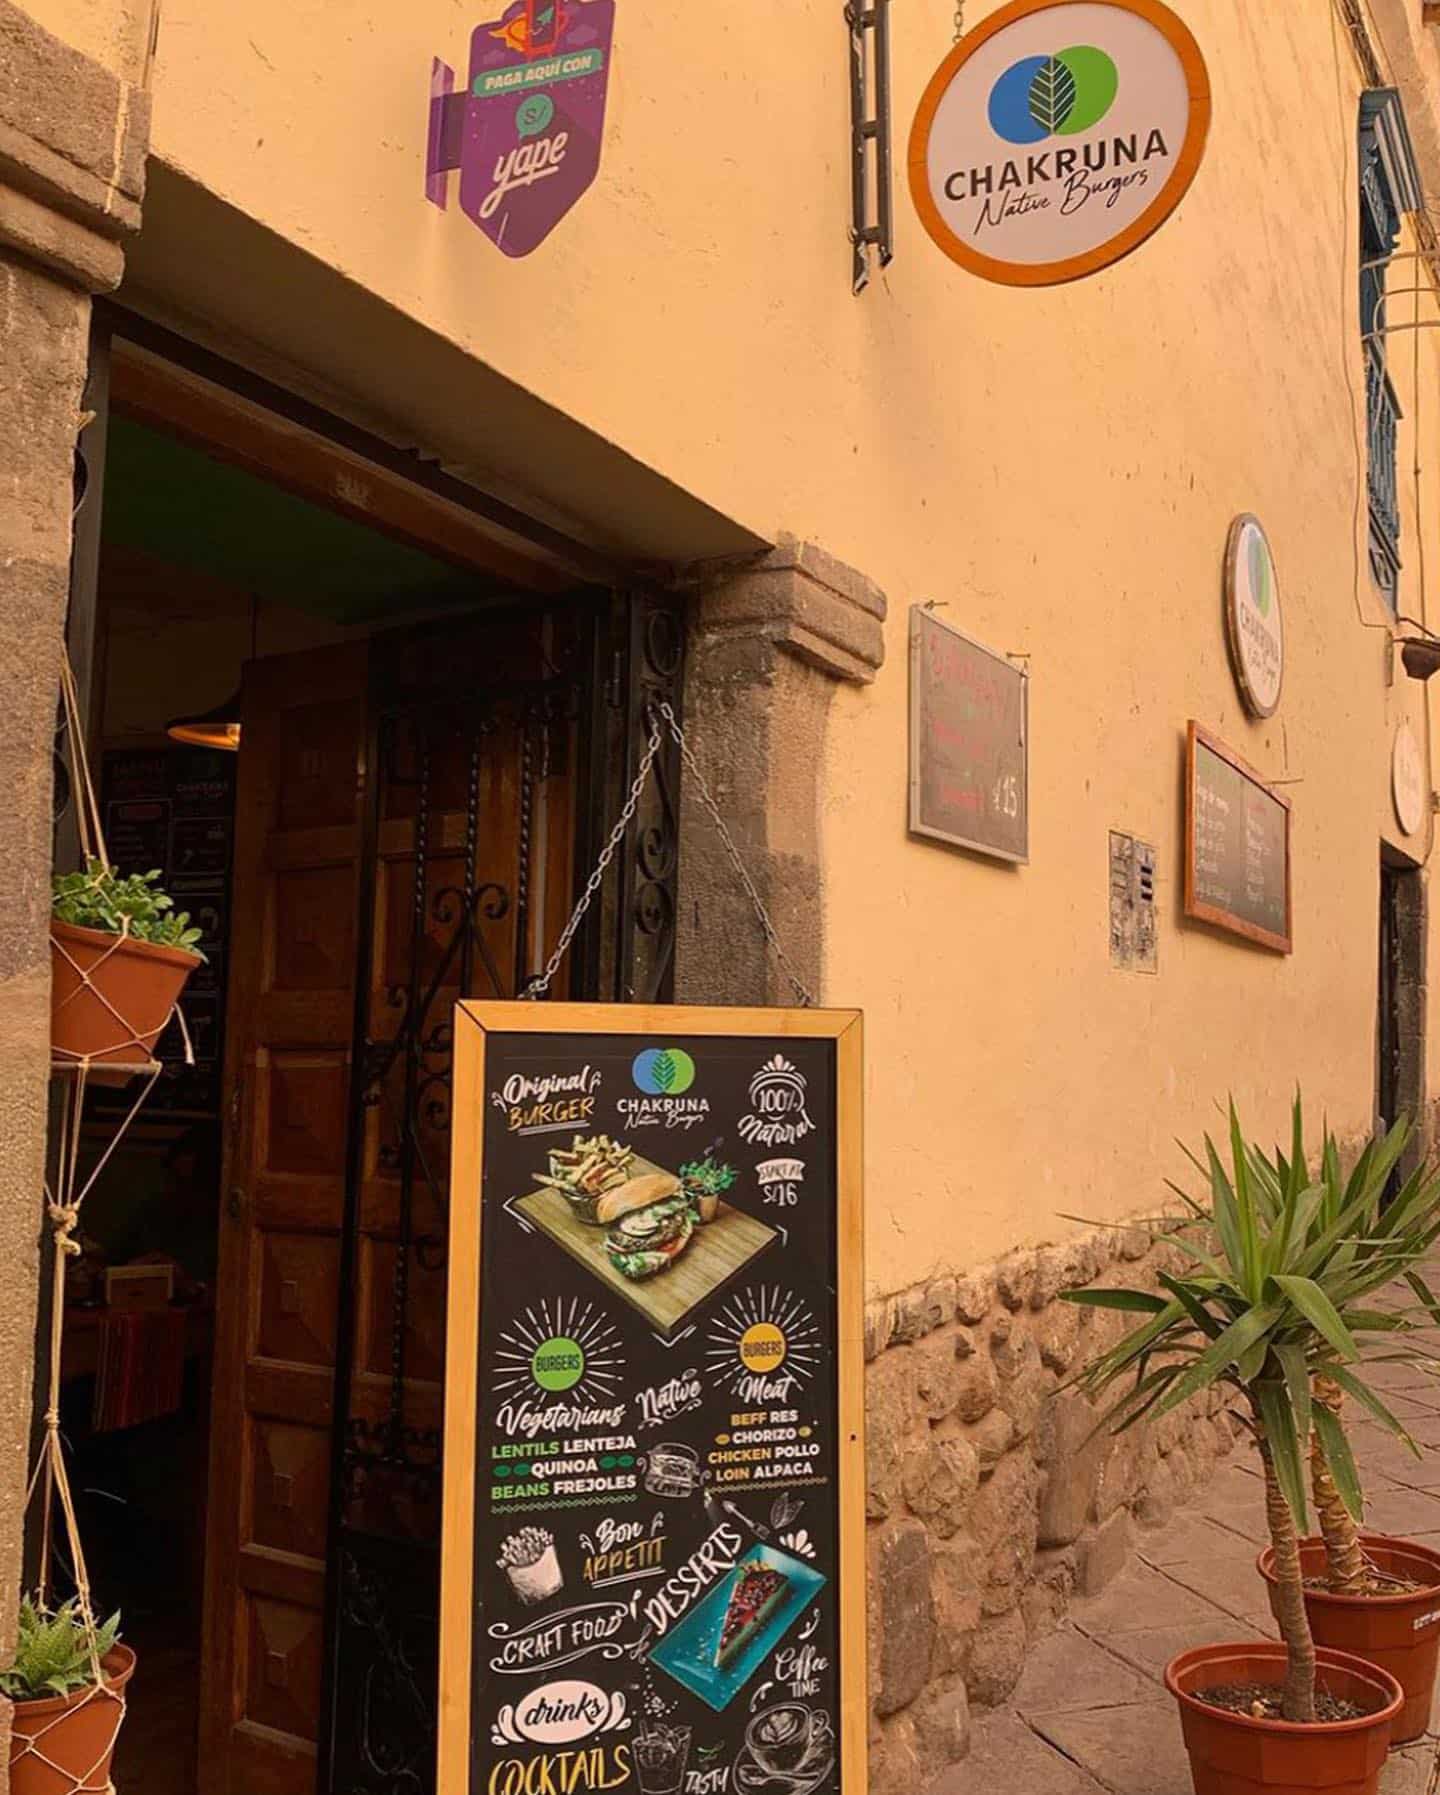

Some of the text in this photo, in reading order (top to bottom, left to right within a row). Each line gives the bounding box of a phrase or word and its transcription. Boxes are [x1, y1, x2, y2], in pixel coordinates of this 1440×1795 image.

[485, 56, 592, 90] PAGA AQUÍ CON
[479, 132, 569, 219] yape
[944, 128, 1169, 201] CHAKRUNA
[974, 168, 1149, 236] Native Burgers
[503, 1065, 590, 1104] Original
[758, 1088, 799, 1113] 100%
[508, 1097, 595, 1131] BURGER
[616, 1098, 711, 1113] CHAKRUNA
[737, 1110, 817, 1148] Natural
[535, 1353, 581, 1373] BURGERS
[743, 1340, 783, 1358] BURGERS
[634, 1376, 703, 1421] Native
[738, 1375, 797, 1405] Meat
[496, 1400, 627, 1439] Vegetarians
[730, 1409, 799, 1427] BEFF RES
[491, 1435, 637, 1459] LENTILS LENTEJA
[732, 1427, 797, 1444] CHORIZO
[531, 1458, 599, 1479] QUINOA
[707, 1443, 820, 1464] CHICKEN POLLO
[491, 1474, 637, 1500] BEANS FREJOLES
[715, 1462, 813, 1482] LOIN ALPACA
[595, 1517, 645, 1554] Bon
[583, 1536, 668, 1583] APPETIT
[643, 1522, 743, 1636] DESSERTS
[502, 1614, 625, 1665] CRAFT FOOD
[775, 1643, 830, 1682] Coffee
[524, 1691, 605, 1727] drinks
[488, 1744, 631, 1795] COCKTAILS
[684, 1765, 731, 1795] TASTY
